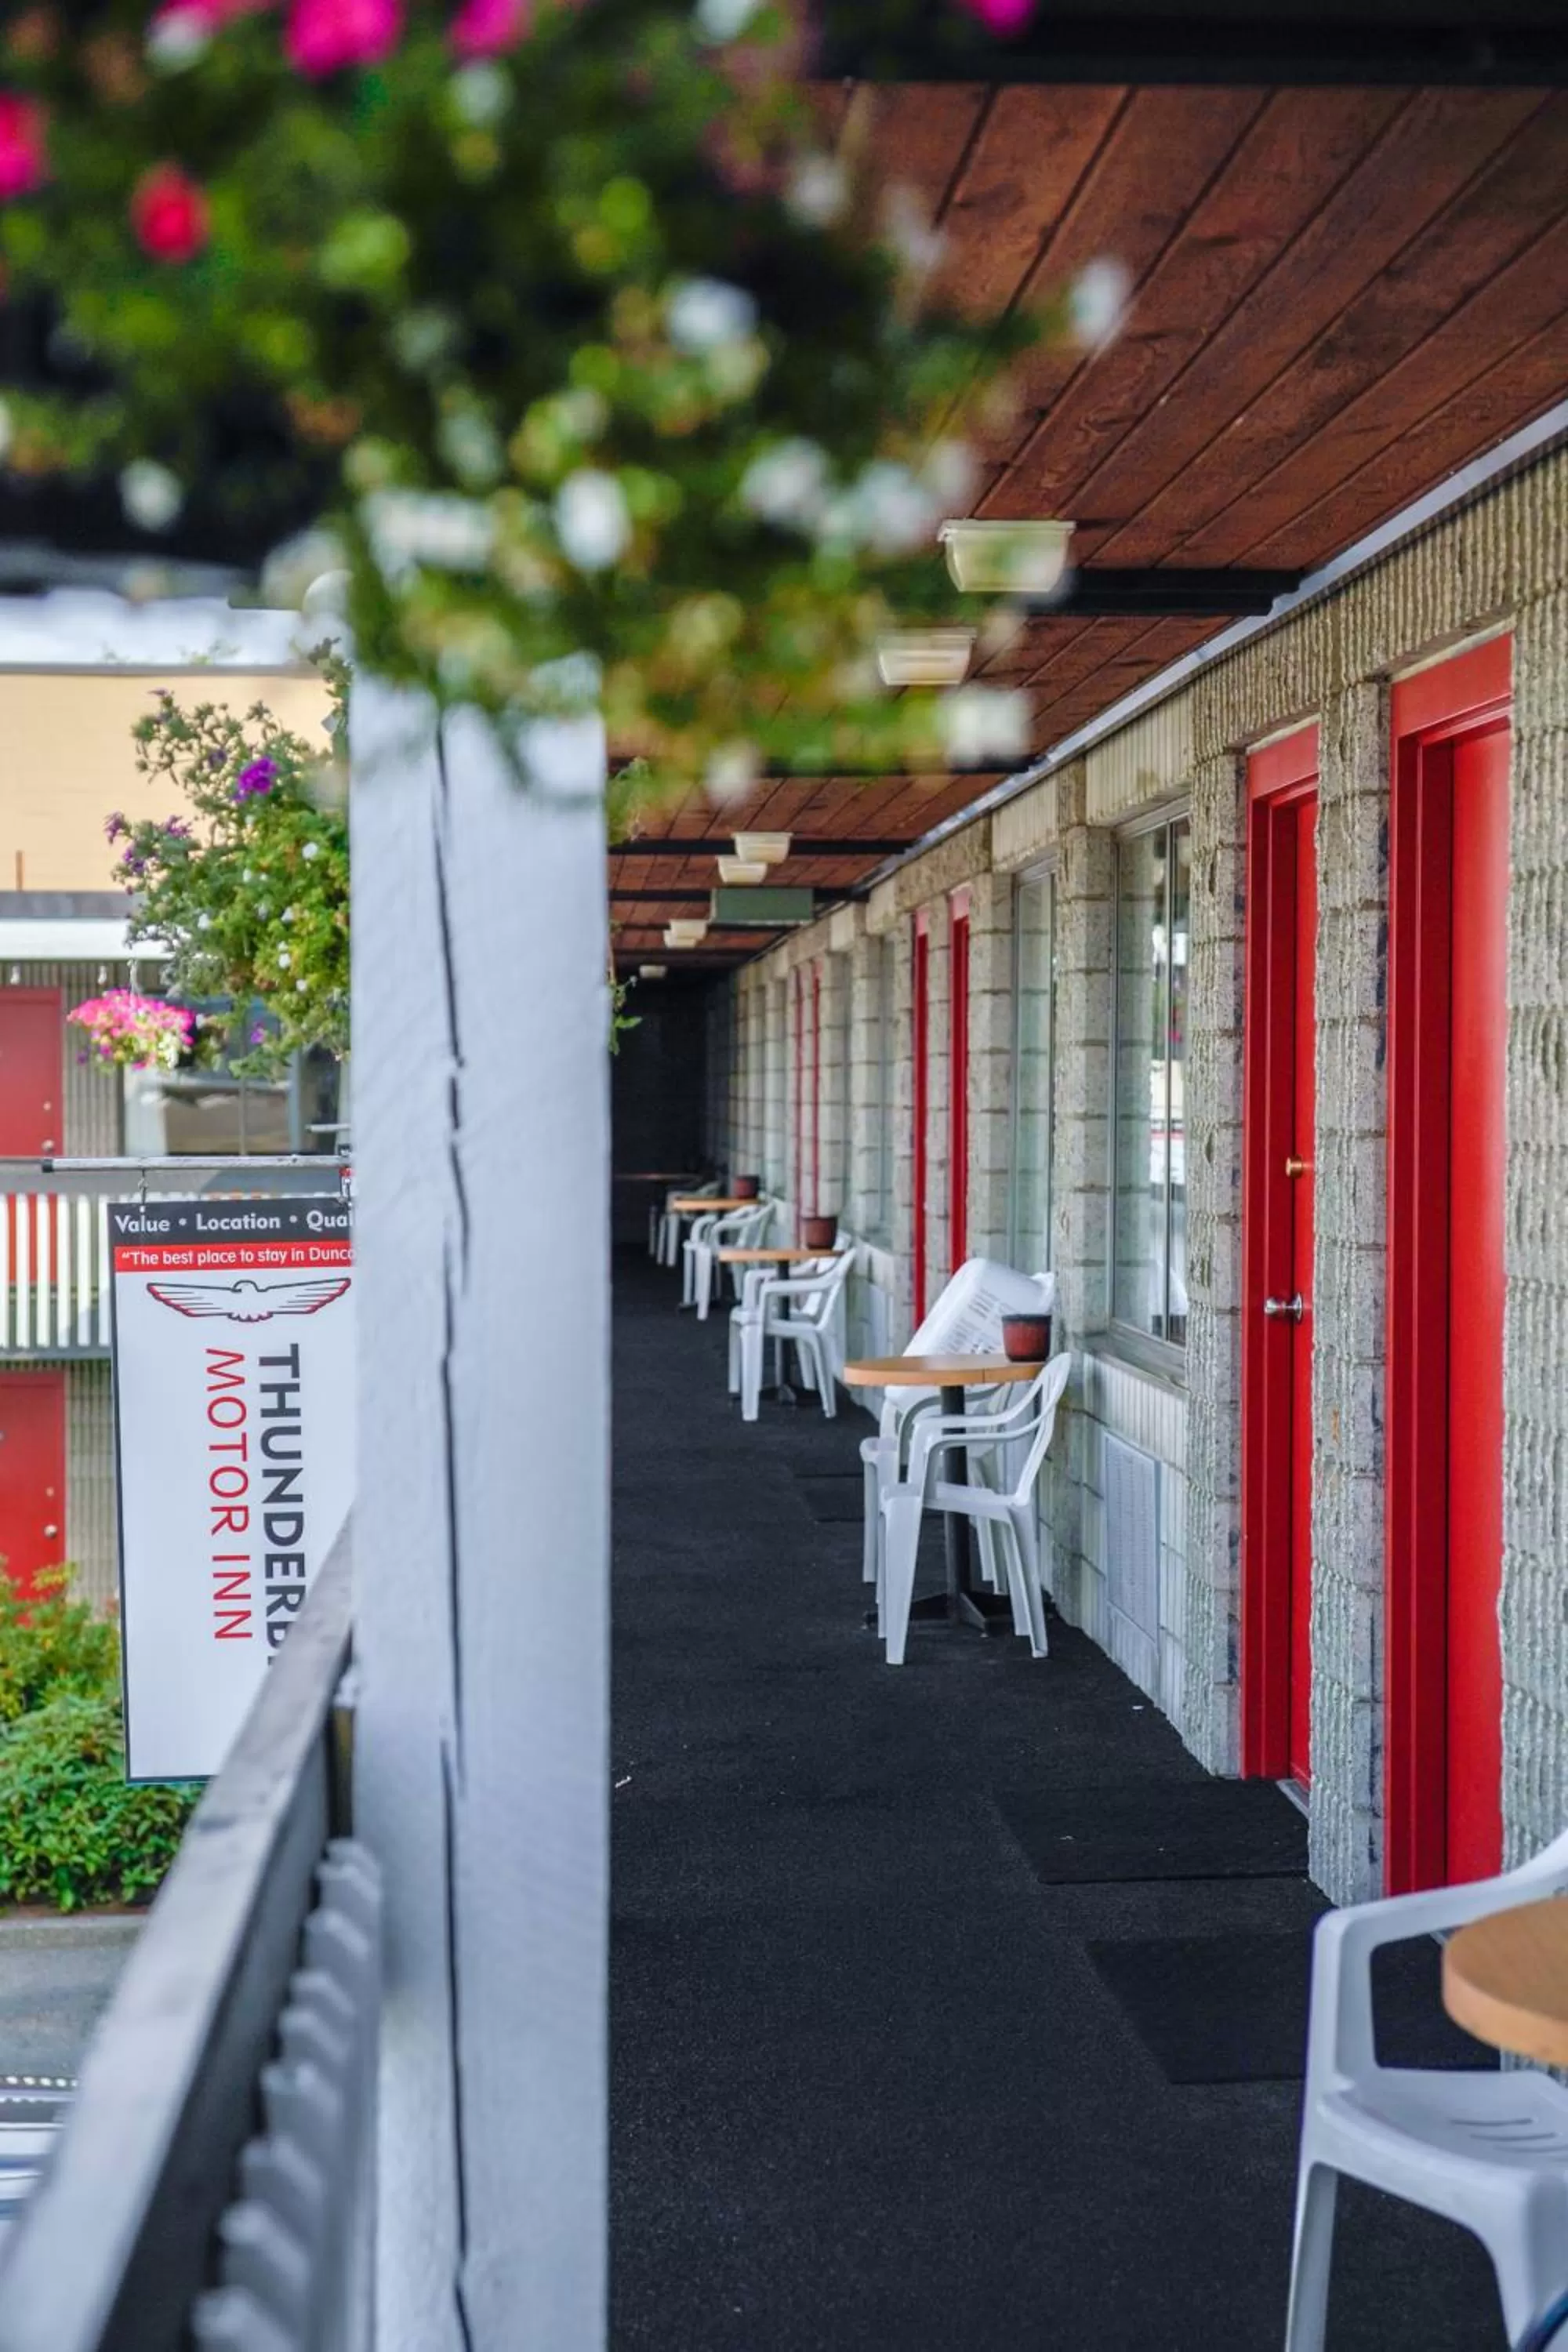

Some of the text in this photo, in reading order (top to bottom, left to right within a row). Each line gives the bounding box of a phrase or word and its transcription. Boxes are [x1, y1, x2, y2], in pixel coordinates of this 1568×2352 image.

[114, 1214, 170, 1232] Value
[196, 1213, 281, 1231] Location
[162, 1250, 194, 1265] best
[198, 1249, 236, 1266] place
[240, 1249, 252, 1262] to
[257, 1247, 287, 1263] stay
[291, 1247, 304, 1261] in
[205, 1348, 253, 1639] MOTOR INN
